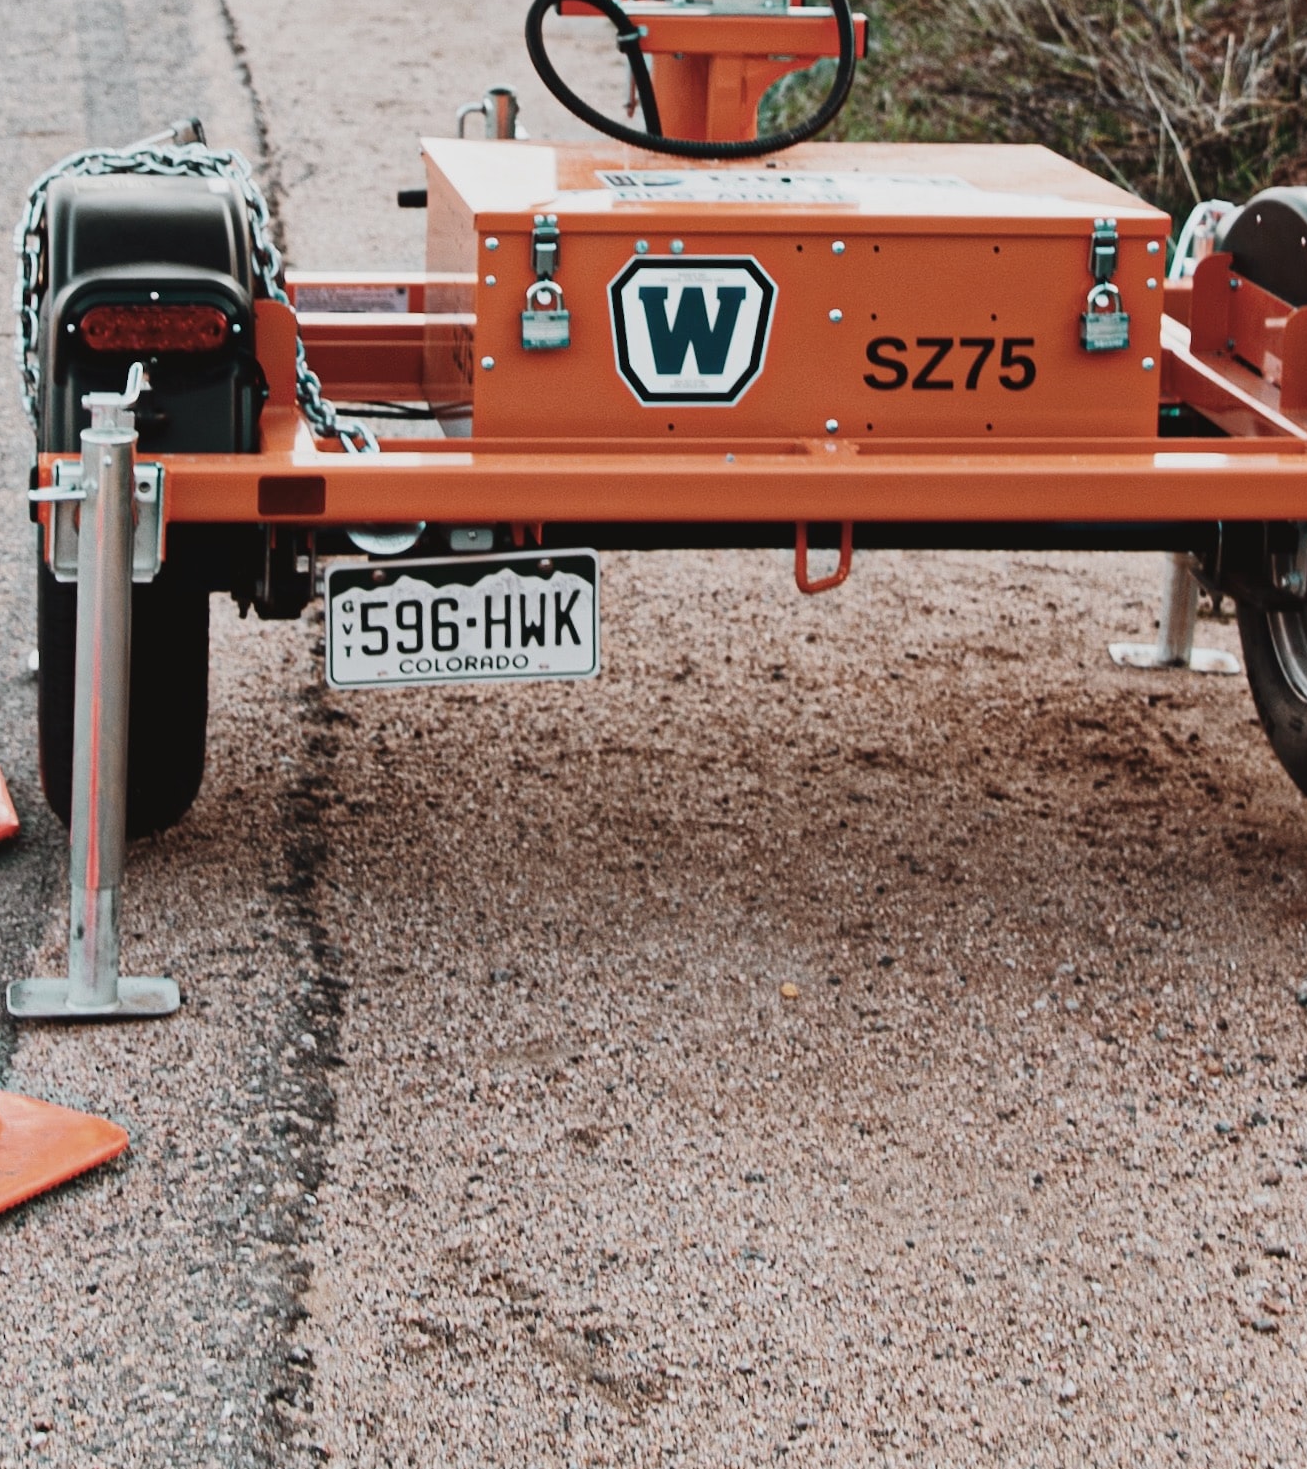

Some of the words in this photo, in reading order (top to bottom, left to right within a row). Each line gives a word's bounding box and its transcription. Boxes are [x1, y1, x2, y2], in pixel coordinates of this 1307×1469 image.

[638, 286, 747, 375] W
[863, 336, 1037, 392] SZ75
[399, 654, 529, 675] COLORADO
